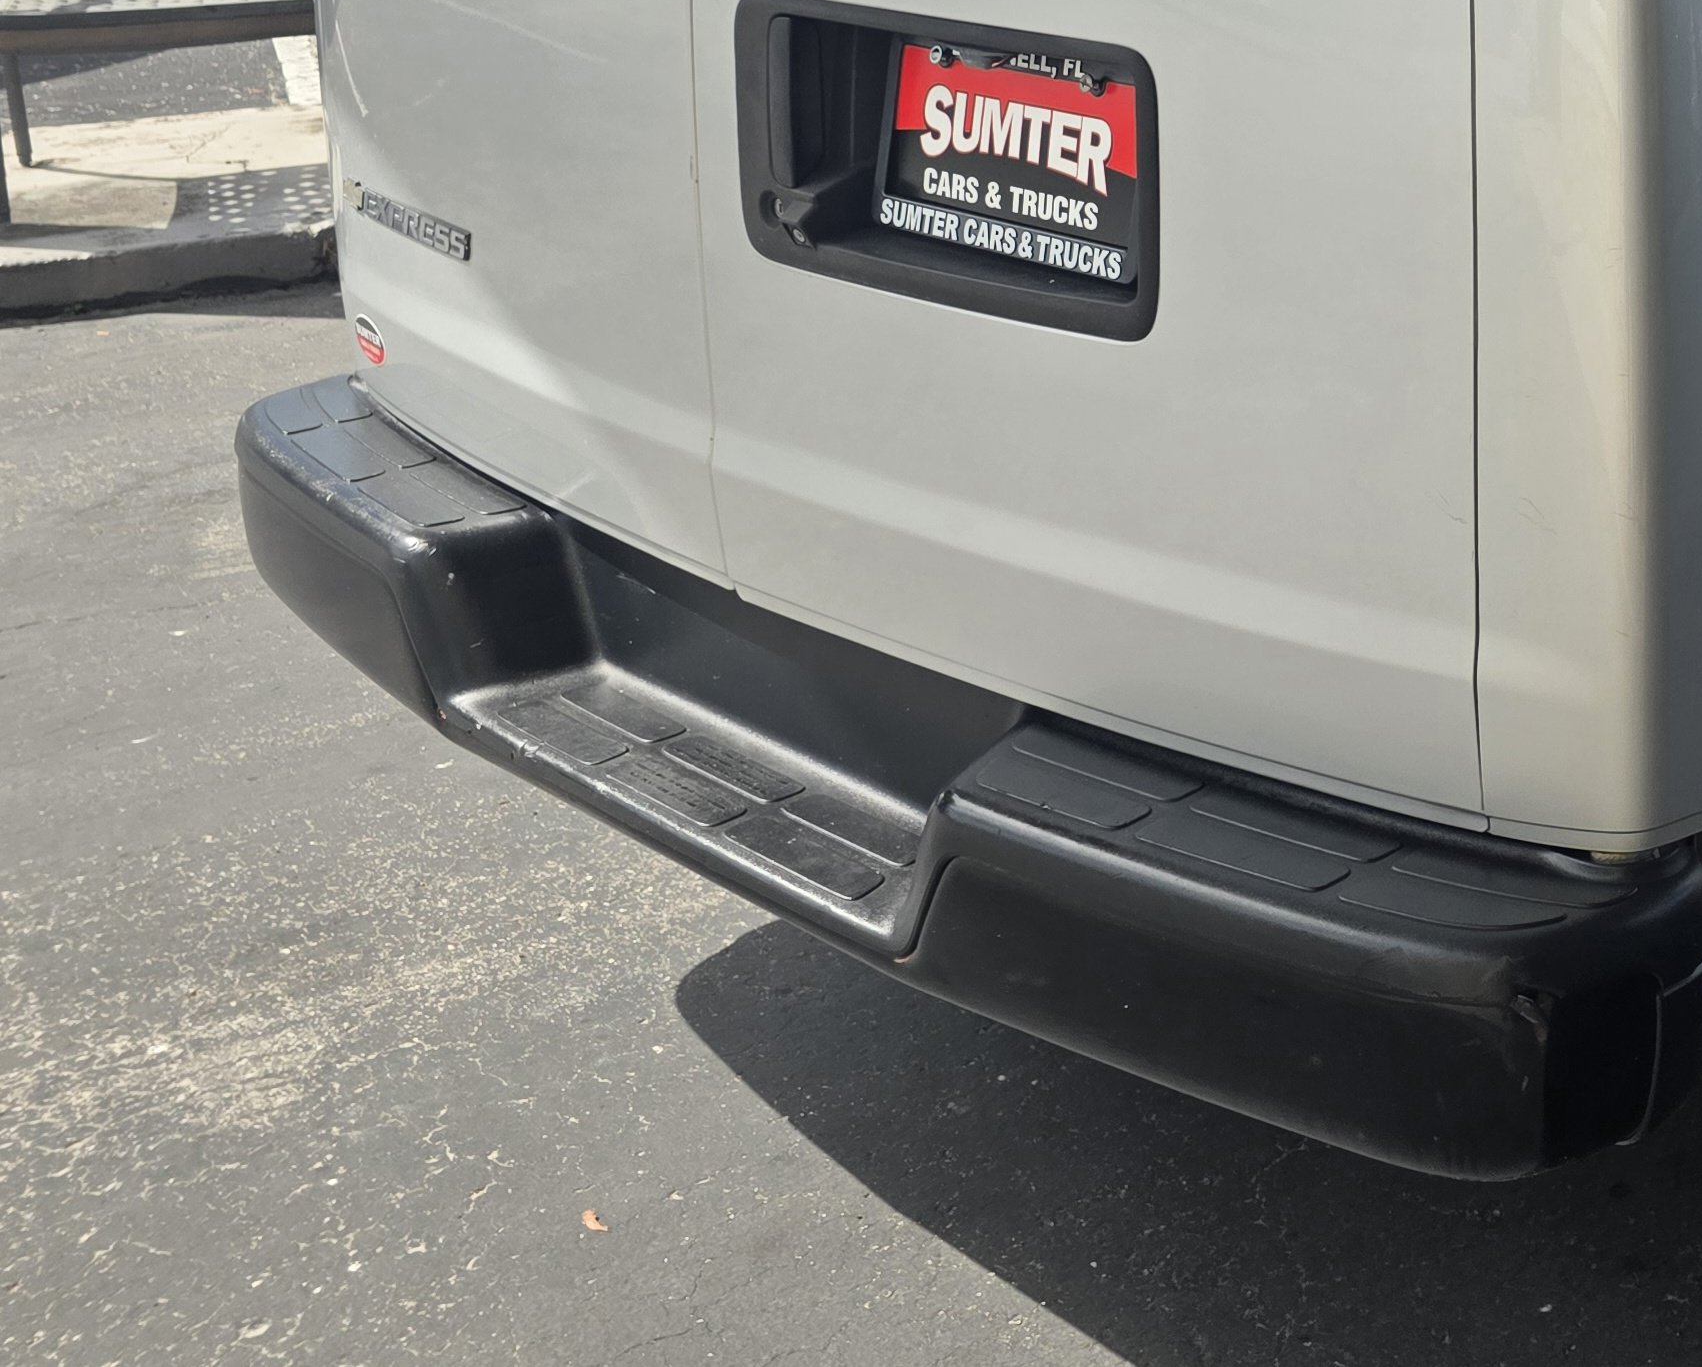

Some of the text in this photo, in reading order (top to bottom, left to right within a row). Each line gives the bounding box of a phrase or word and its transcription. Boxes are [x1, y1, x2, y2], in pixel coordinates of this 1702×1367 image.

[1010, 52, 1086, 79] ELL, FL
[919, 84, 1114, 198] SUMTER
[364, 188, 466, 261] EXPRESS
[923, 166, 1099, 231] CARS & TRUCKS
[879, 197, 1123, 281] SUMTER CARS & TRUCKS
